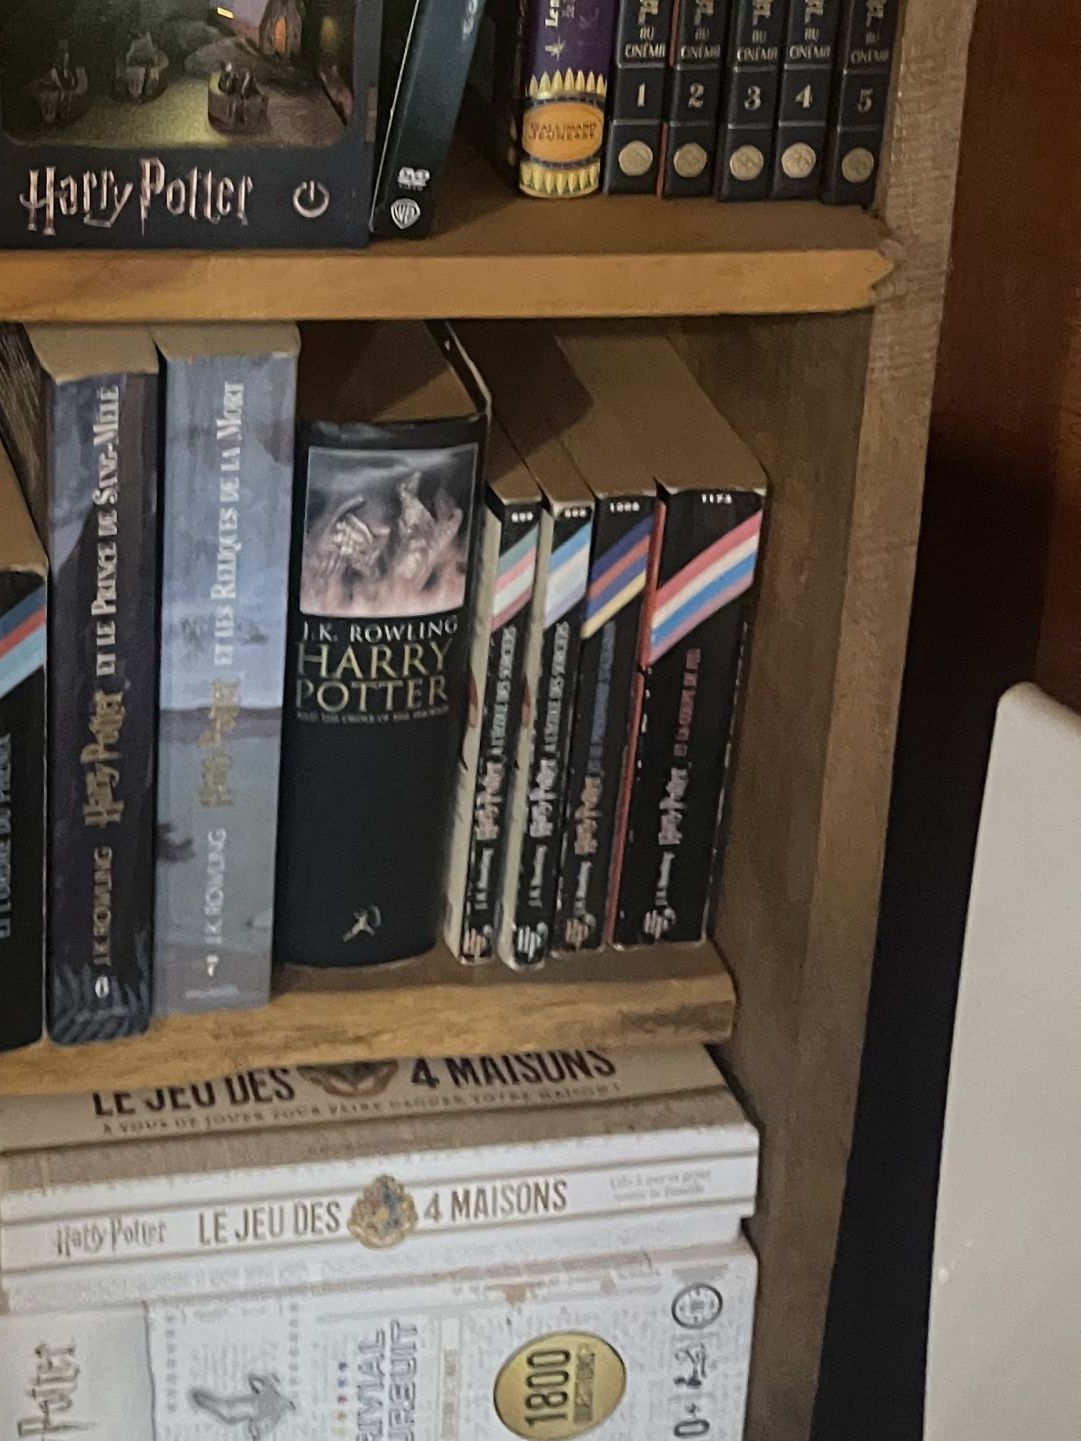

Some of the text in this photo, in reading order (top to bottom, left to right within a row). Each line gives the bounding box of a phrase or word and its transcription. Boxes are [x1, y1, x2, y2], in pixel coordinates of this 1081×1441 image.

[638, 83, 646, 107] 1
[688, 83, 704, 108] 2
[744, 86, 761, 110] 3
[795, 84, 813, 108] 4
[857, 89, 873, 112] 5
[19, 157, 253, 236] Harry Potter
[350, 615, 459, 643] ROWLING
[297, 638, 452, 679] HARRY
[296, 675, 448, 712] POTTER
[94, 846, 112, 936] ROWLING
[93, 1049, 617, 1116] LE JEU DES 4 MAISONS
[198, 1211, 226, 1247] LE
[235, 1206, 286, 1242] JEU
[294, 1200, 342, 1236] DES
[423, 1192, 443, 1224] 4
[451, 1178, 569, 1222] MAISONS
[110, 1214, 167, 1252] Potter
[525, 1348, 572, 1428] 1800
